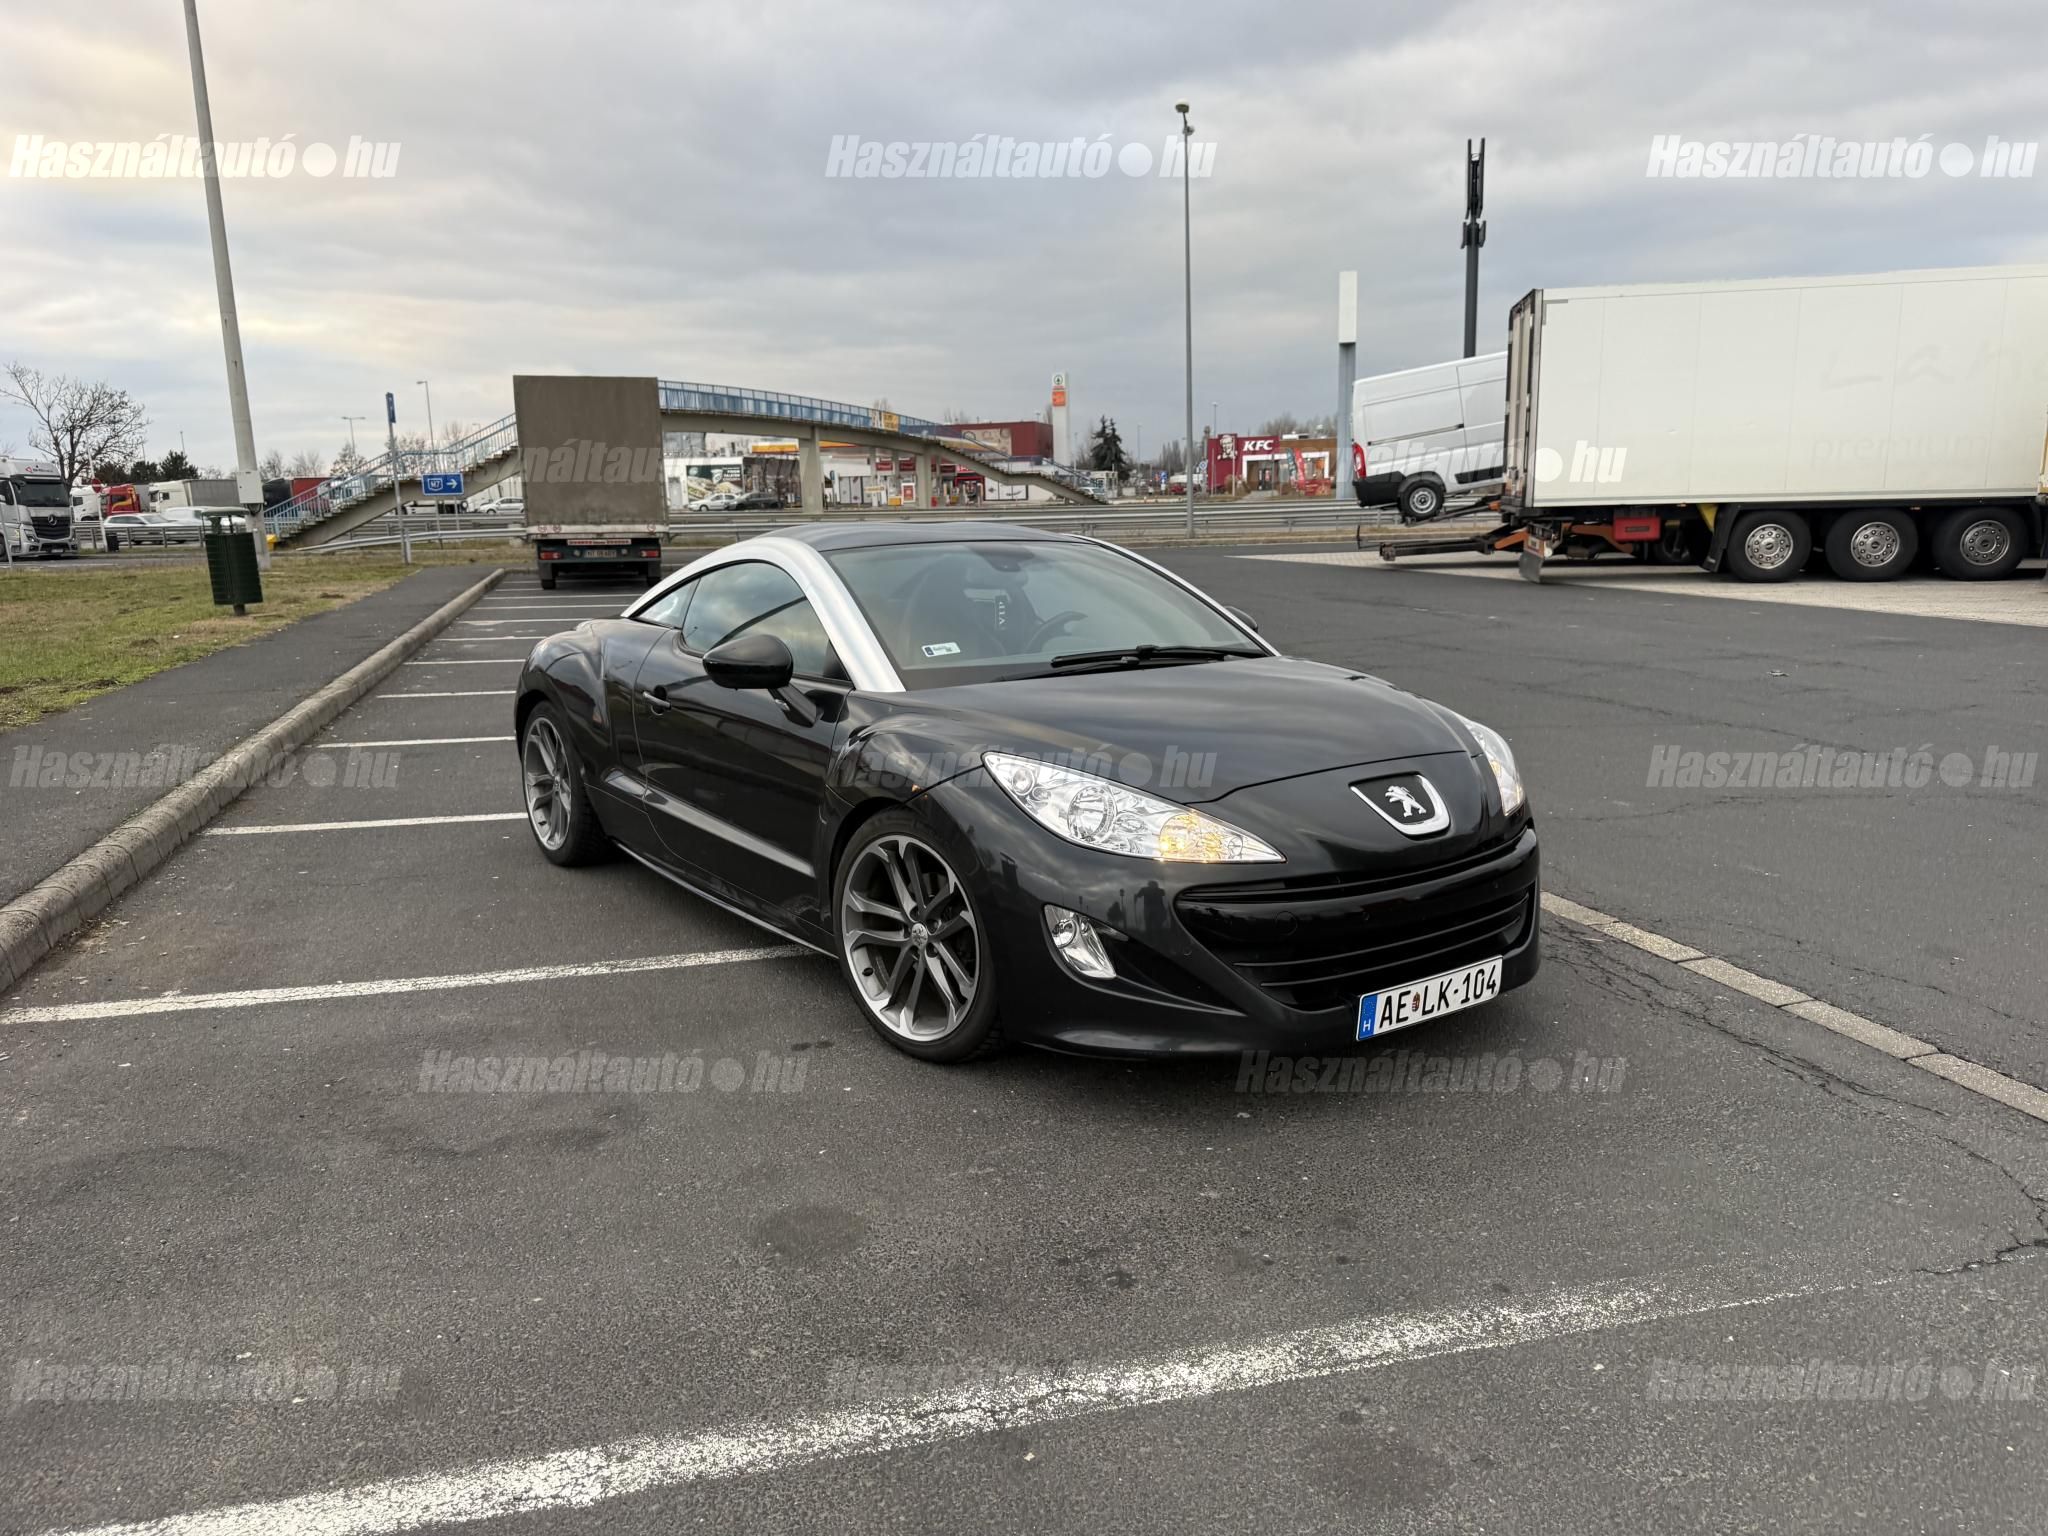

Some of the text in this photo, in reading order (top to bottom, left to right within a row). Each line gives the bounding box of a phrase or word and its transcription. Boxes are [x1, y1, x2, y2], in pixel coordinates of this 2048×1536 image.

[1243, 439, 1273, 451] KFC
[1362, 964, 1497, 1032] H AE LK-104
